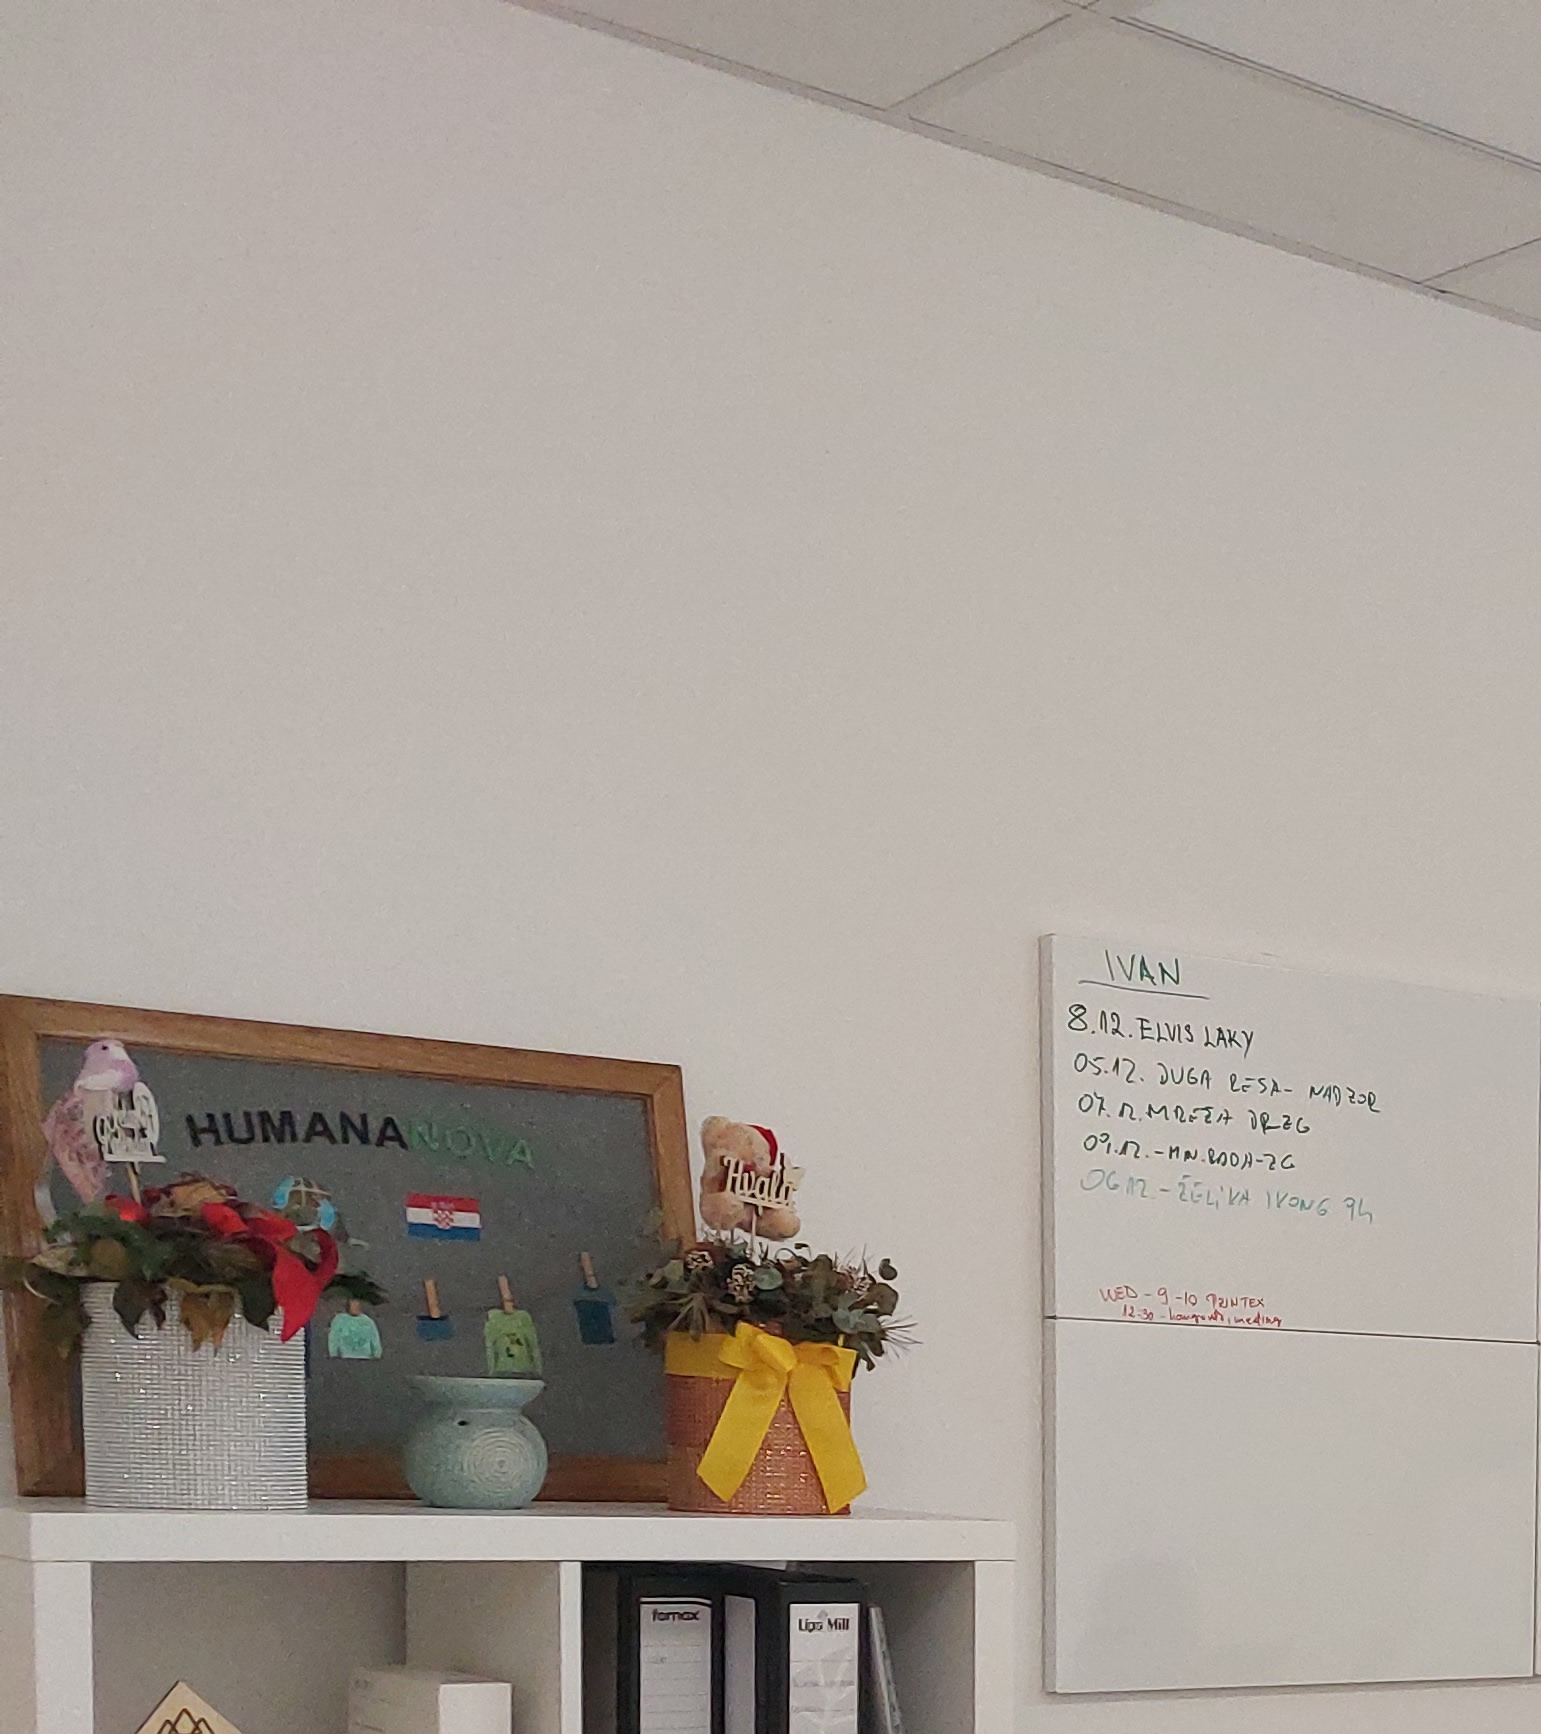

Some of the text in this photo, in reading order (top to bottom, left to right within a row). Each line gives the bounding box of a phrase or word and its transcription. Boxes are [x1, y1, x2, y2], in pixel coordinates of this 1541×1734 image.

[1103, 949, 1180, 986] IVAN
[1135, 1017, 1194, 1043] ELVIS
[1203, 1025, 1254, 1059] LAKY
[1157, 1062, 1213, 1090] DUGA
[1308, 1084, 1381, 1113] NADZOR
[1099, 1284, 1138, 1302] WED
[827, 1617, 850, 1632] Mill
